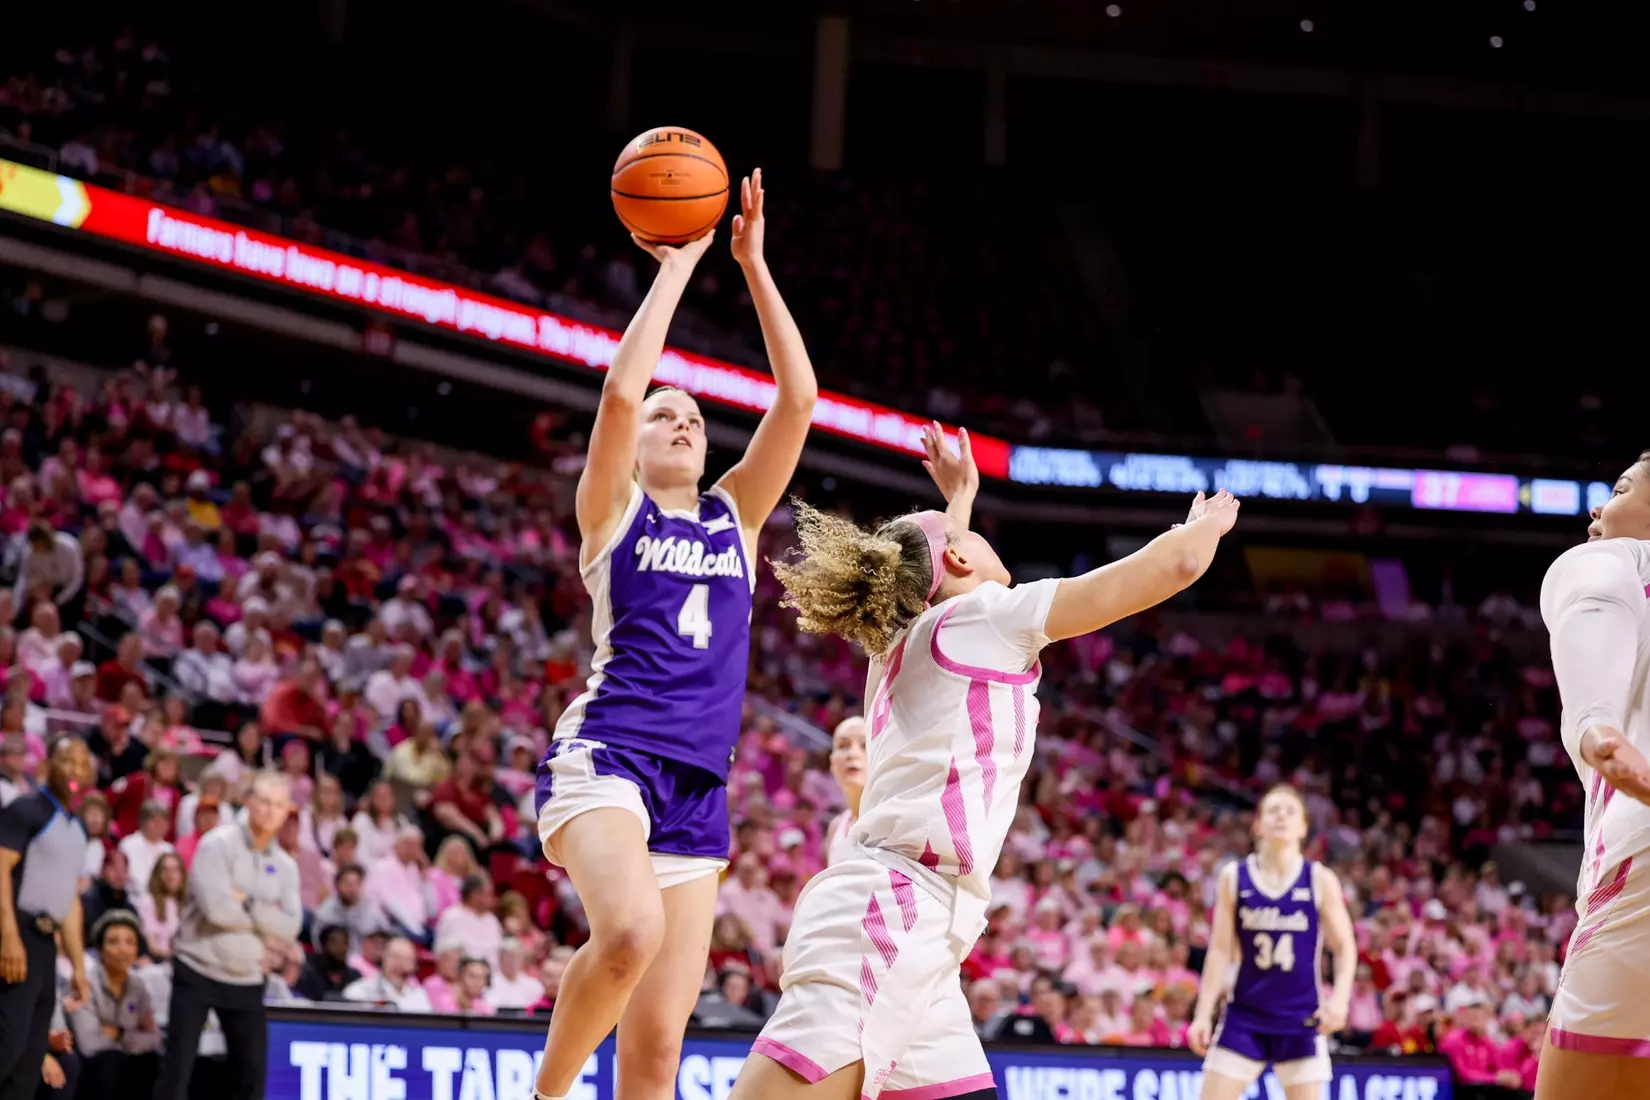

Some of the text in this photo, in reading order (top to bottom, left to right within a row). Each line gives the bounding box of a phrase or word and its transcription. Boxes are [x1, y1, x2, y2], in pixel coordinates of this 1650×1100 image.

[634, 535, 744, 579] Wildcats
[677, 583, 713, 650] 4
[1252, 932, 1296, 973] 34
[289, 1040, 408, 1100] THE
[421, 1046, 599, 1100] TABE
